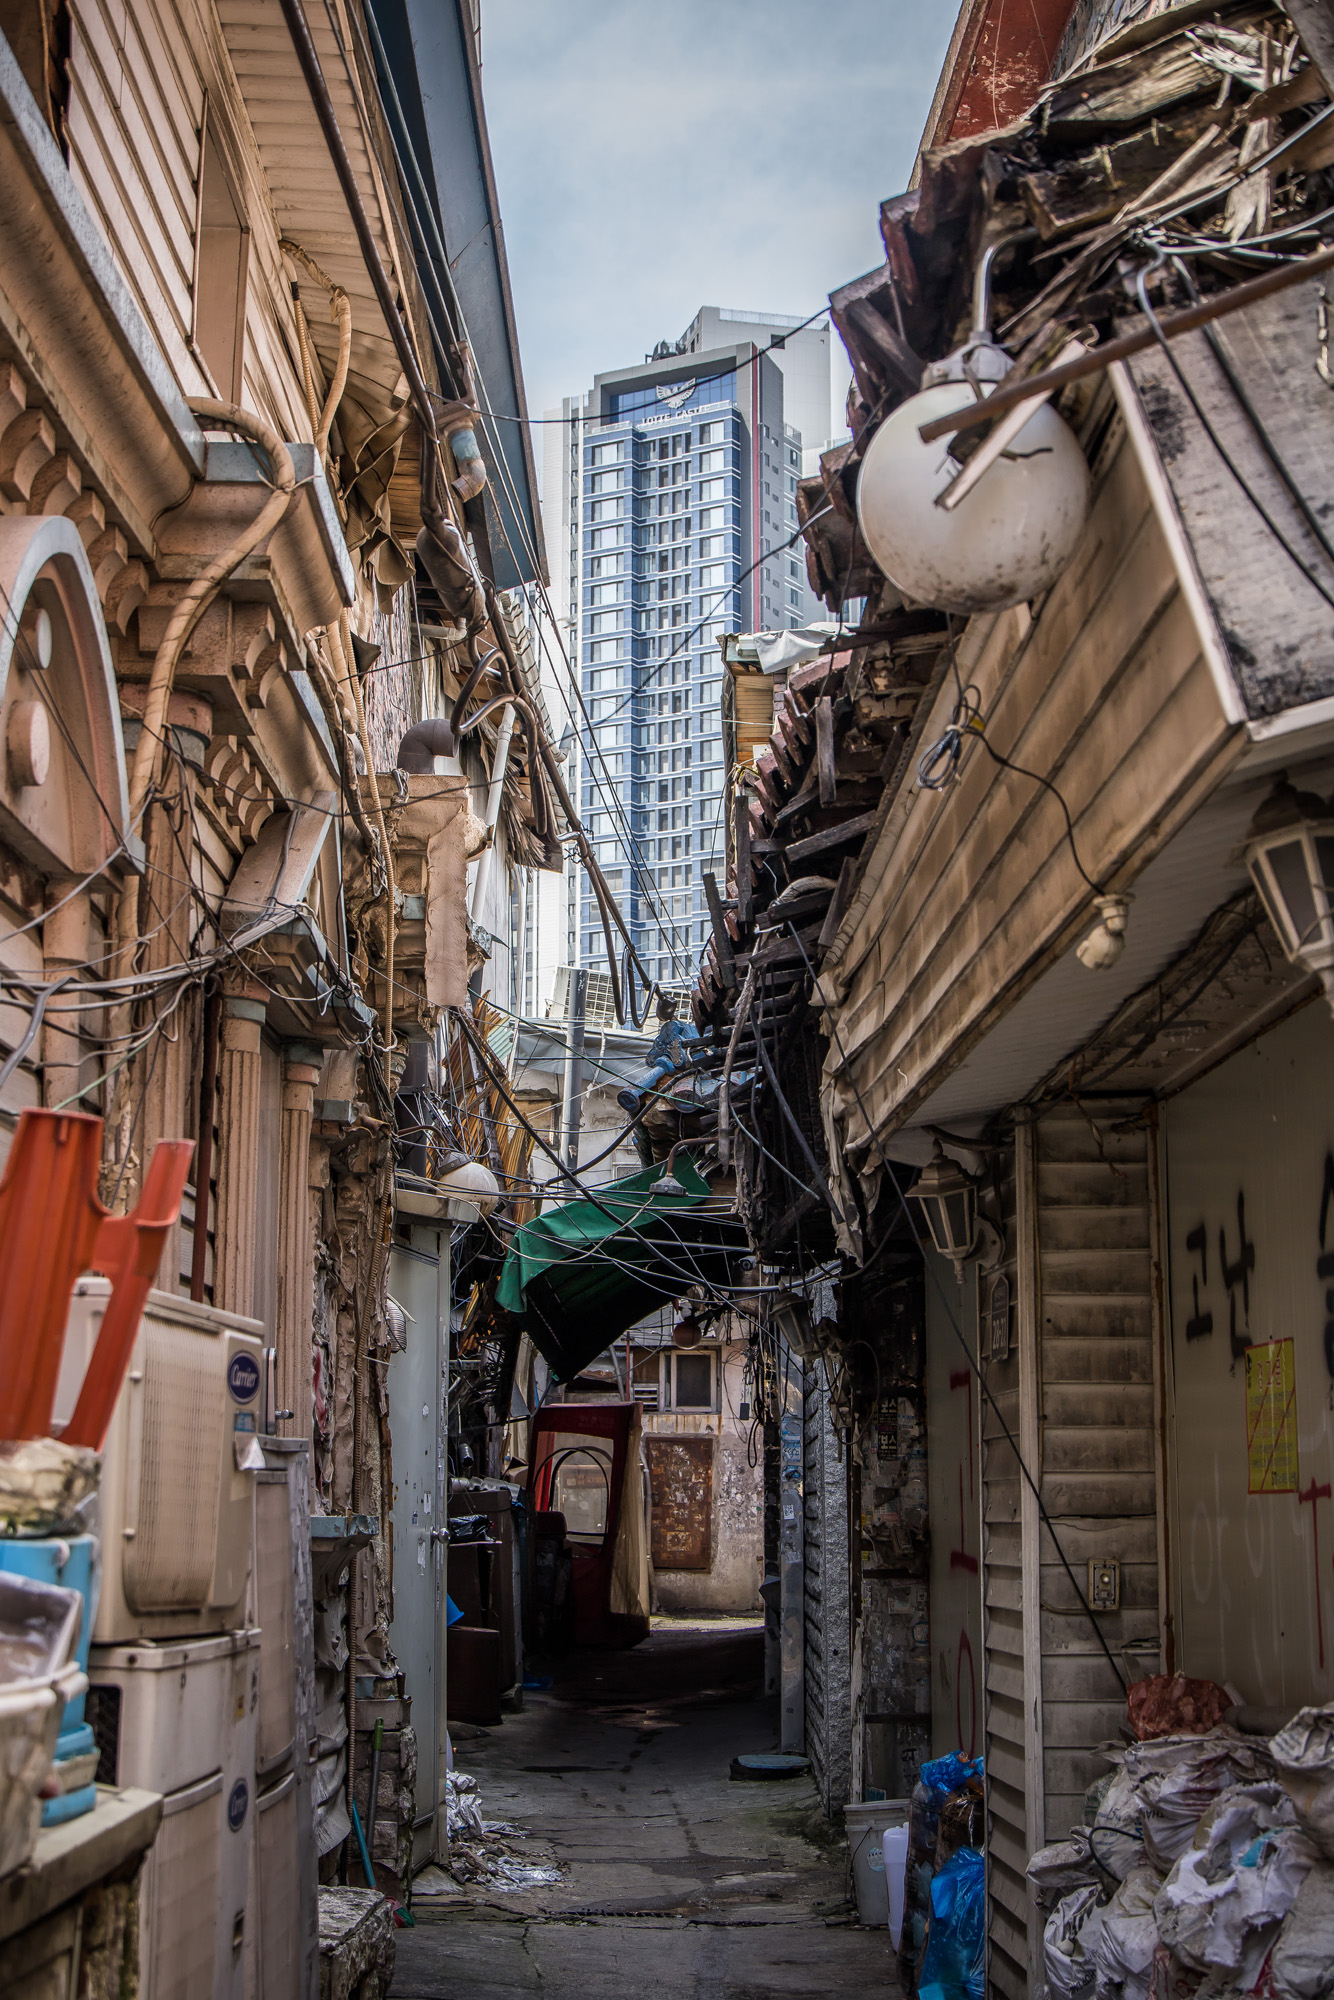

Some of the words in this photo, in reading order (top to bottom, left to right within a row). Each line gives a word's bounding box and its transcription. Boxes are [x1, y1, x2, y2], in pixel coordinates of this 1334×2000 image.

[642, 413, 671, 425] LOTTE
[231, 1364, 258, 1388] Carrier
[1257, 1357, 1282, 1391] 경고문
[880, 1434, 897, 1449] 보스
